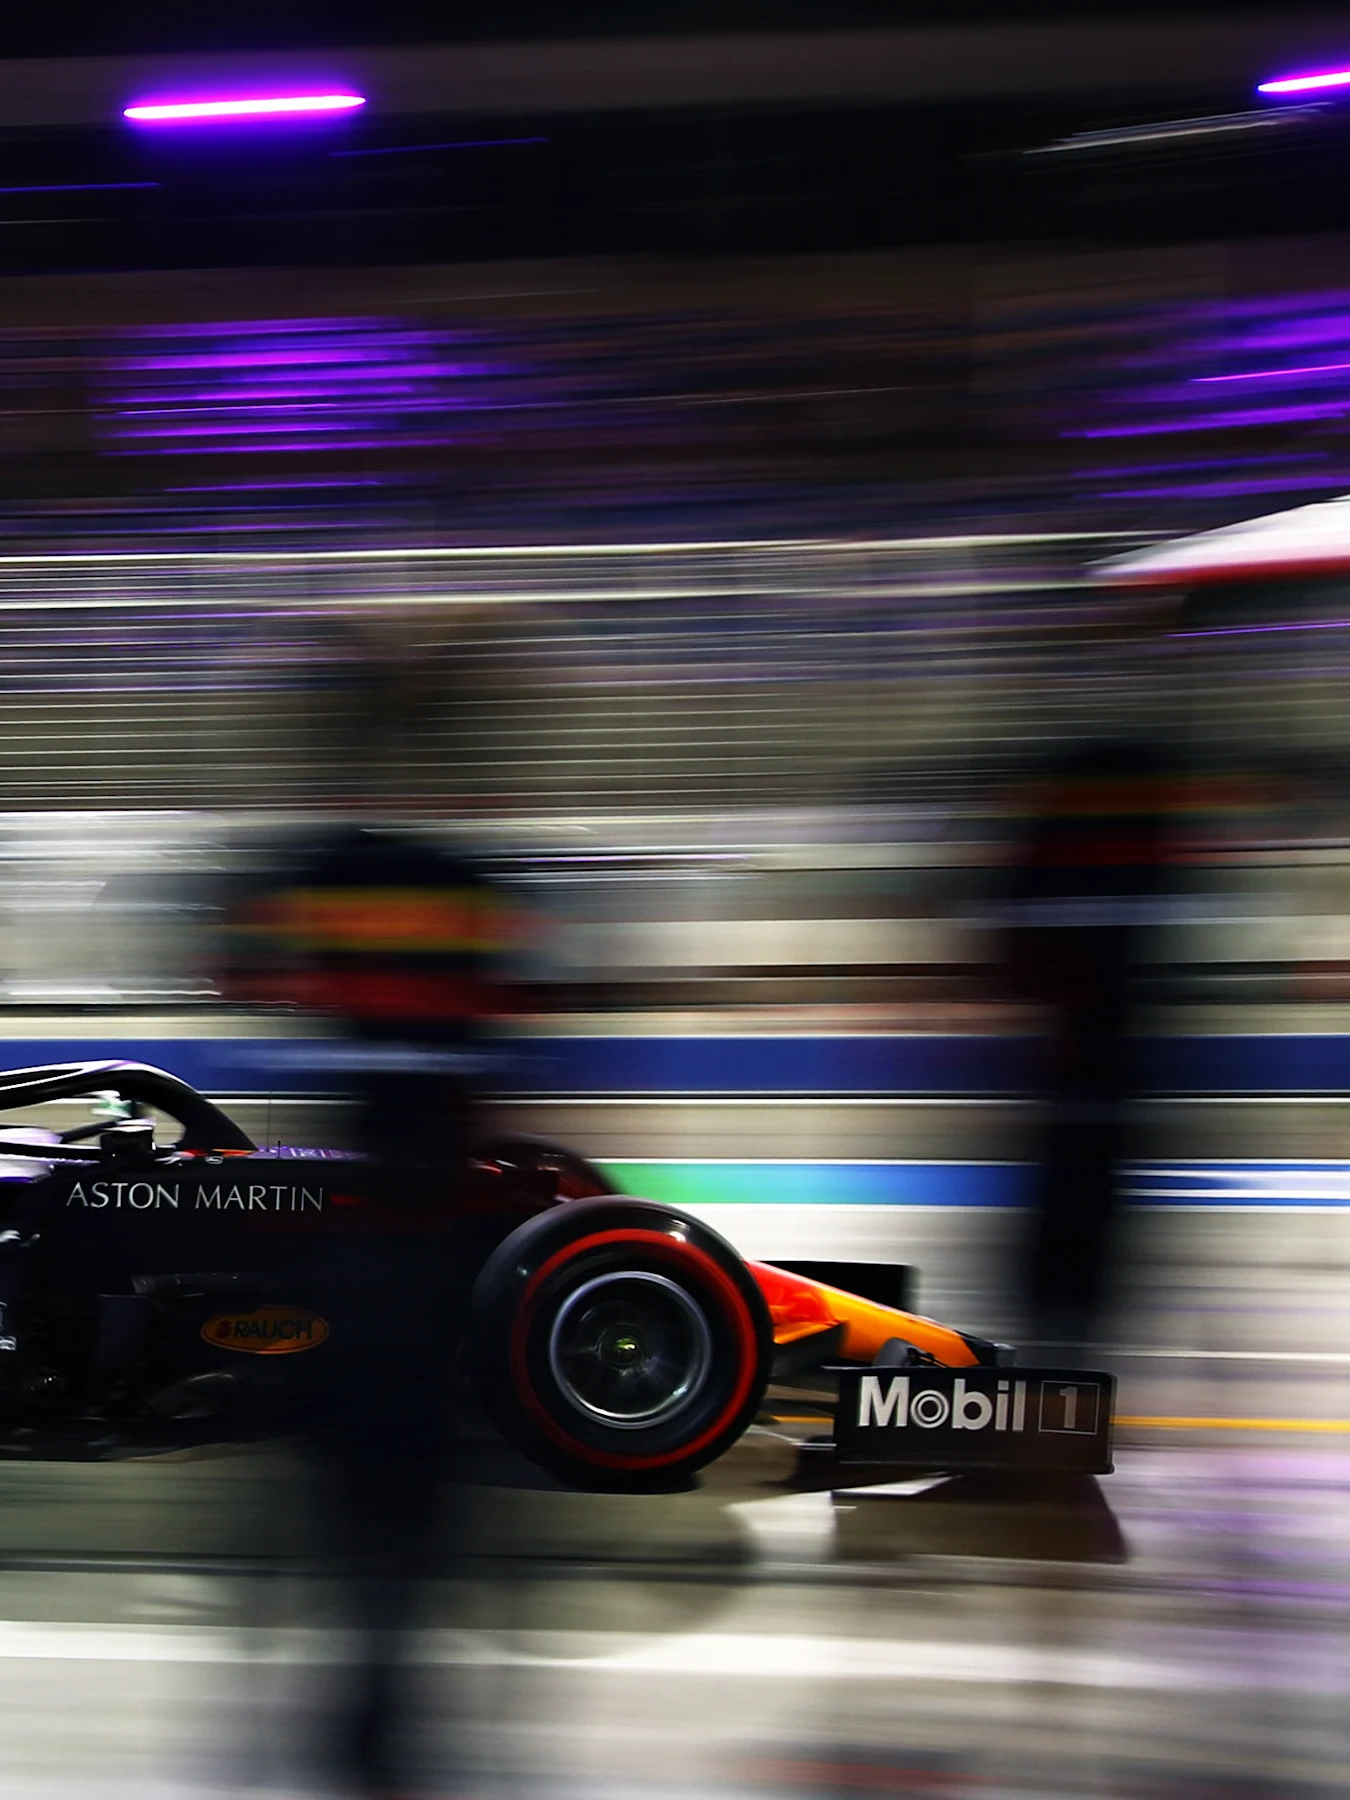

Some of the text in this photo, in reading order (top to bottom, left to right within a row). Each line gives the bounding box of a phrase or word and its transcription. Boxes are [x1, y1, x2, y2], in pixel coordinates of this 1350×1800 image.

[66, 1182, 324, 1212] ASTON MARTIN
[233, 1319, 313, 1340] RAUCH
[857, 1375, 1078, 1432] Mobil 1
